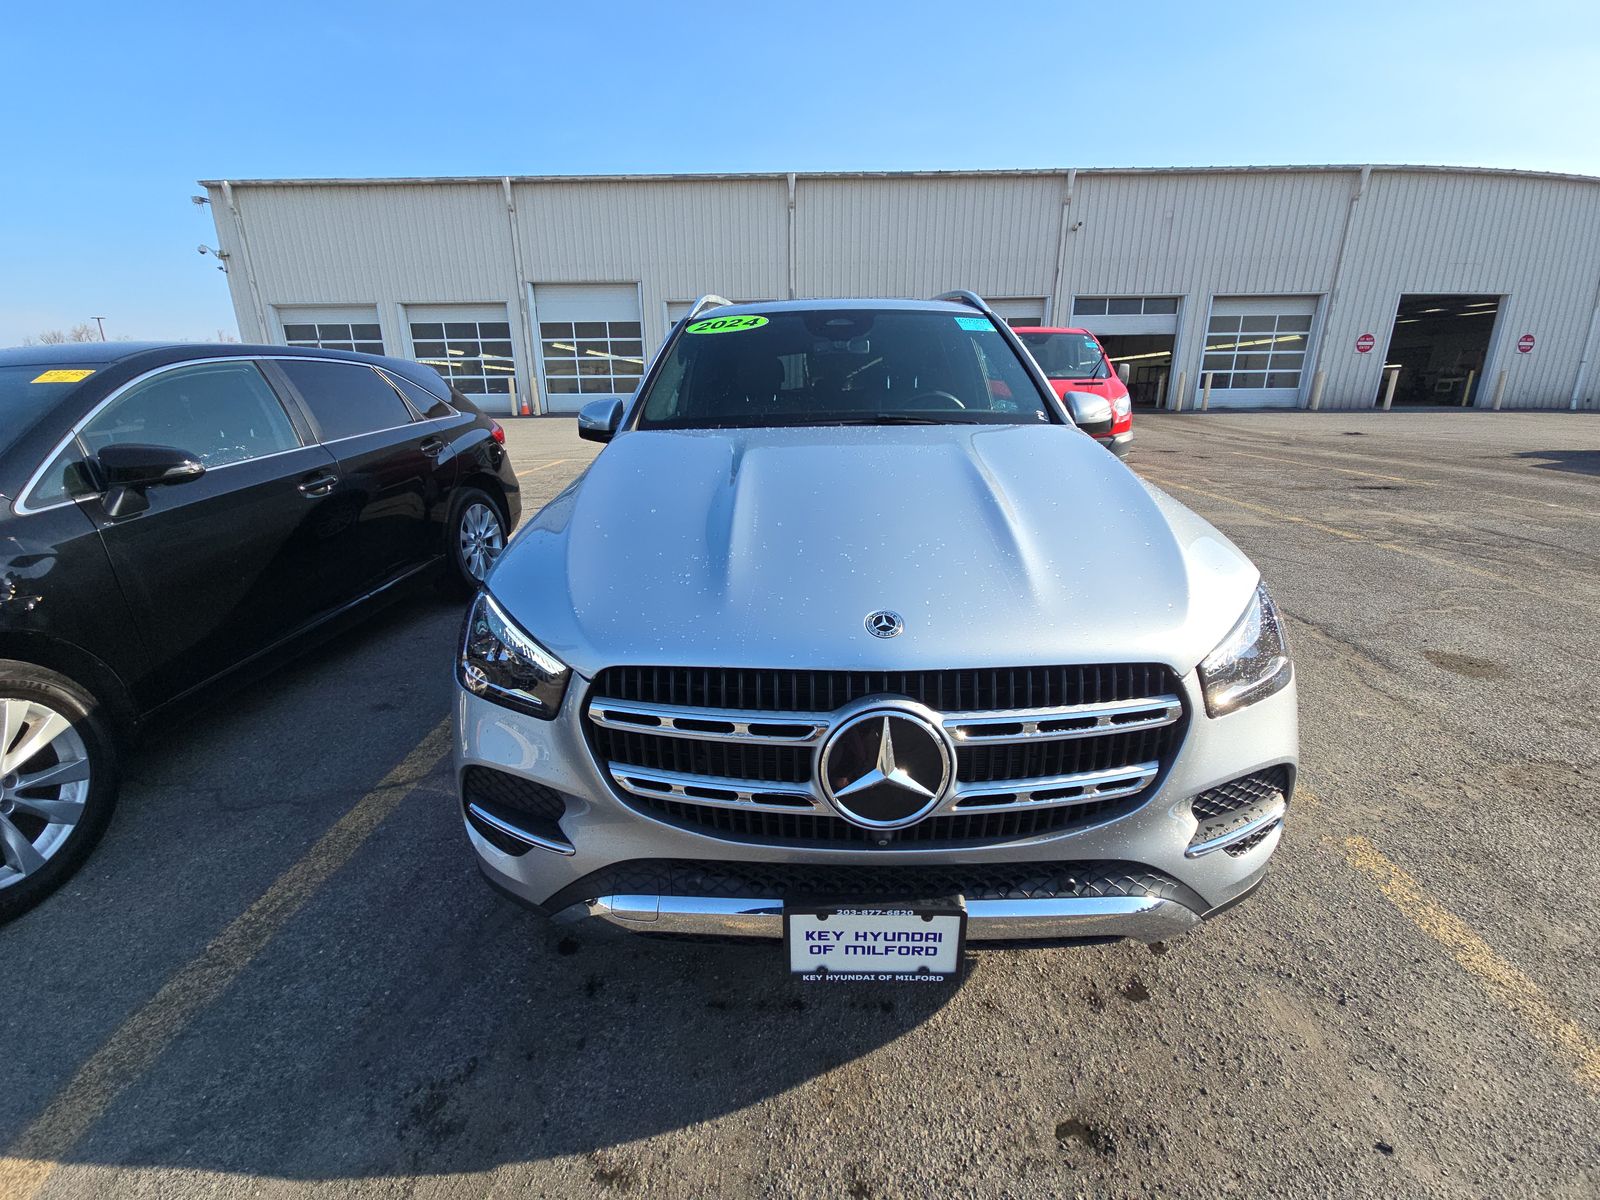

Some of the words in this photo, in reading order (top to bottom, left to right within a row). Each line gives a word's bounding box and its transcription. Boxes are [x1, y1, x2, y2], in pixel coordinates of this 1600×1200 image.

[693, 317, 760, 332] 2024
[805, 930, 845, 941] KEY
[854, 931, 943, 943] HYUNDAI
[809, 944, 836, 955] OF
[844, 945, 938, 957] MILFORD
[895, 974, 944, 982] MILFORD
